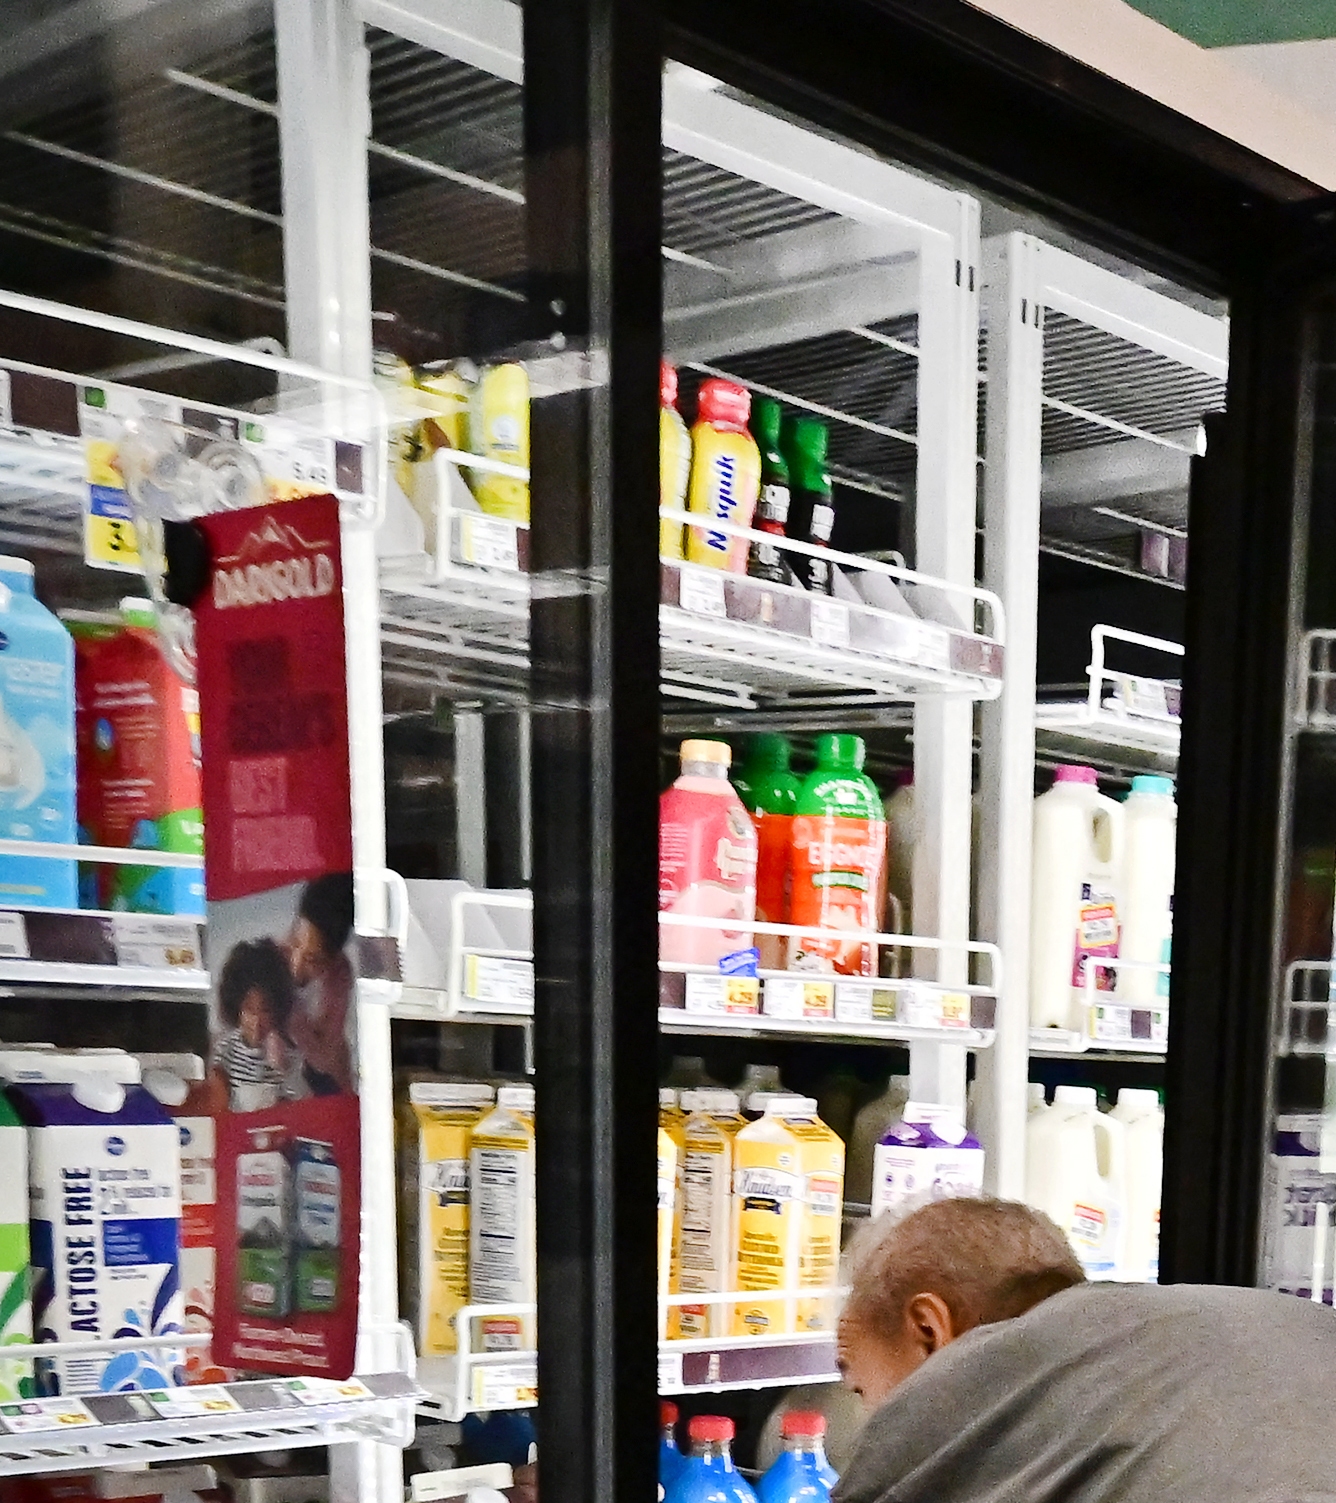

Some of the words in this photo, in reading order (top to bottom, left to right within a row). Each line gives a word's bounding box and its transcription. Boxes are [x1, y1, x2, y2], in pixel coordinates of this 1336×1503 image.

[215, 552, 335, 610] DARIGOLD
[61, 1166, 94, 1226] FREE
[65, 1235, 101, 1340] ACTOSE
